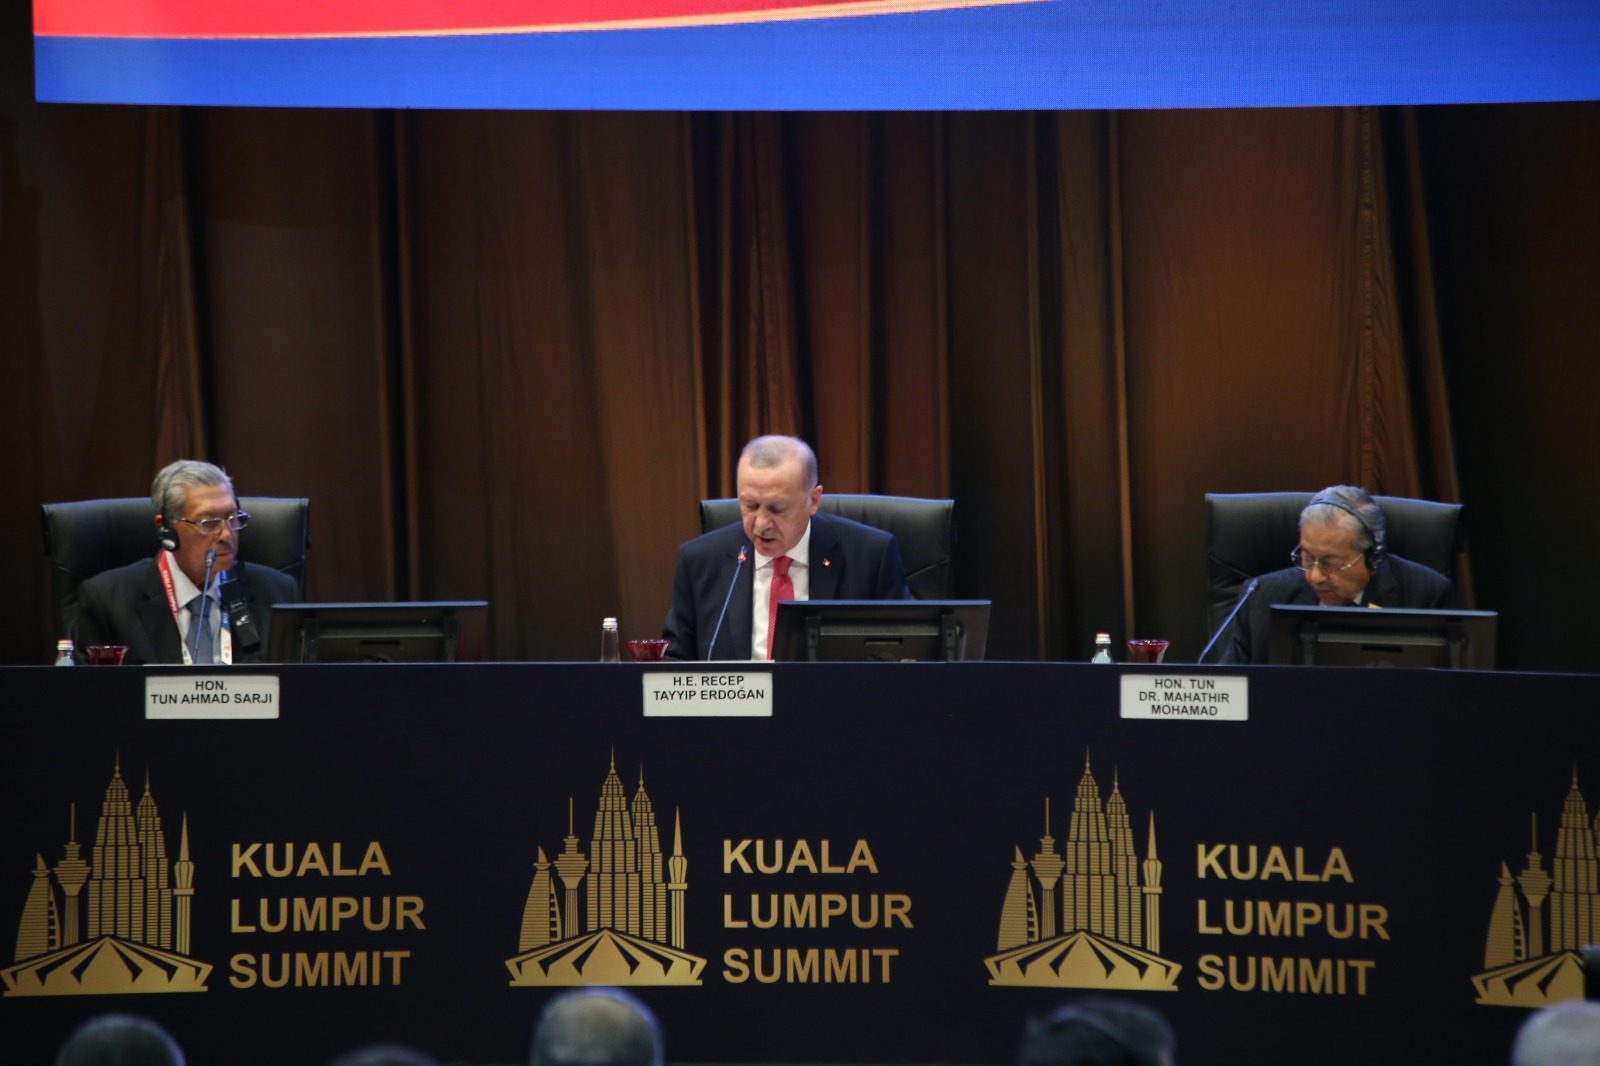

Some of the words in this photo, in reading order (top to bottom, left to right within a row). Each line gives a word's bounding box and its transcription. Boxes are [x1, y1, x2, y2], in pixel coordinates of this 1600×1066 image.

[151, 693, 177, 704] TUN
[181, 693, 230, 704] AHMAD
[234, 693, 271, 704] SARJI
[195, 680, 228, 691] HON.
[653, 690, 697, 700] TAYYIP
[700, 686, 765, 700] ERDOĞAN
[673, 676, 697, 686] H.E.
[701, 675, 744, 686] RECEP
[1139, 691, 1161, 702] DR.
[1164, 692, 1230, 703] MAHATHIR
[1155, 678, 1186, 690] HON.
[1190, 679, 1215, 690] TUN
[1151, 704, 1218, 716] MOHAMAD
[231, 841, 391, 878] KUALA
[722, 838, 880, 875] KUALA
[1196, 843, 1354, 882] KUALA
[230, 894, 426, 934] LUMPUR
[722, 892, 914, 930] LUMPUR
[1196, 899, 1390, 941] LUMPUR
[229, 951, 411, 989] SUMMIT
[722, 946, 900, 985] SUMMIT
[1197, 954, 1376, 996] SUMMIT
